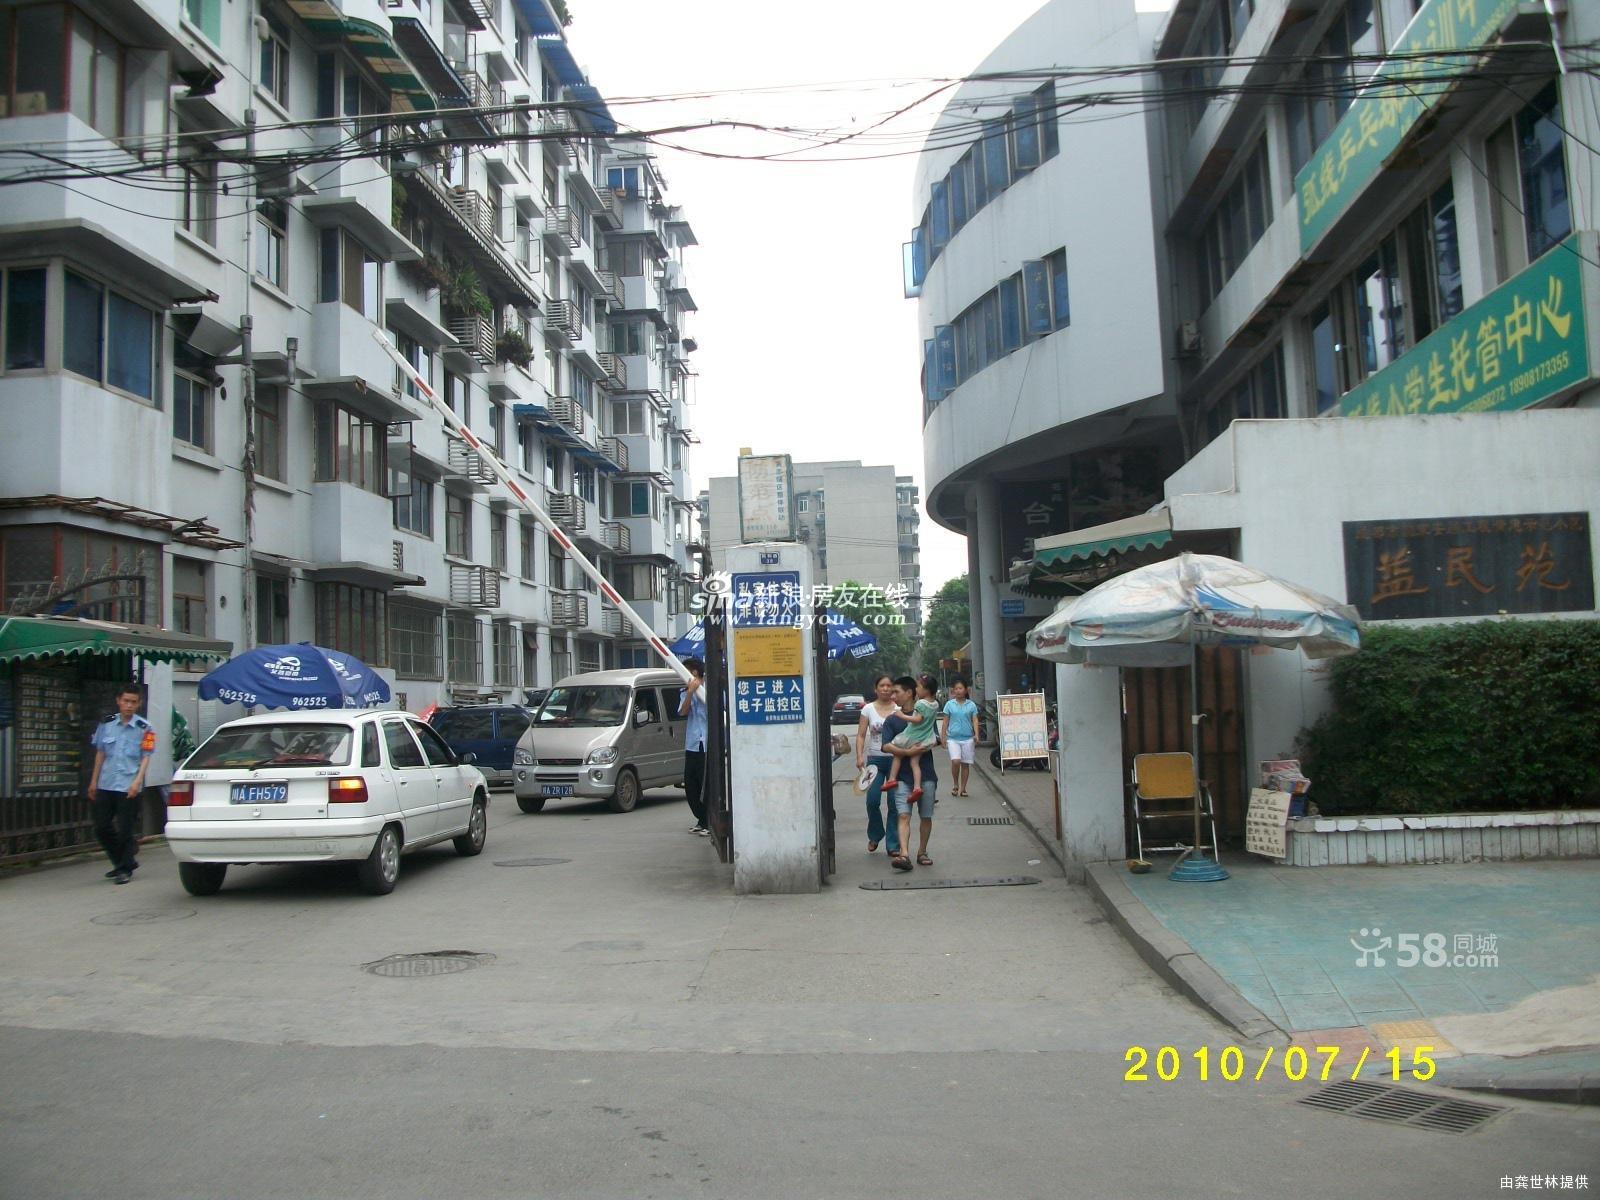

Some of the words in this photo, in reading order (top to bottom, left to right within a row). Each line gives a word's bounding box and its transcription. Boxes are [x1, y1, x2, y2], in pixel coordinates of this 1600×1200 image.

[737, 679, 802, 695] 您已进入
[218, 688, 257, 703] 962525
[292, 697, 327, 706] 962525
[738, 696, 802, 713] 电子监控区
[1001, 698, 1042, 714] 房屋租售
[249, 786, 286, 800] FH579
